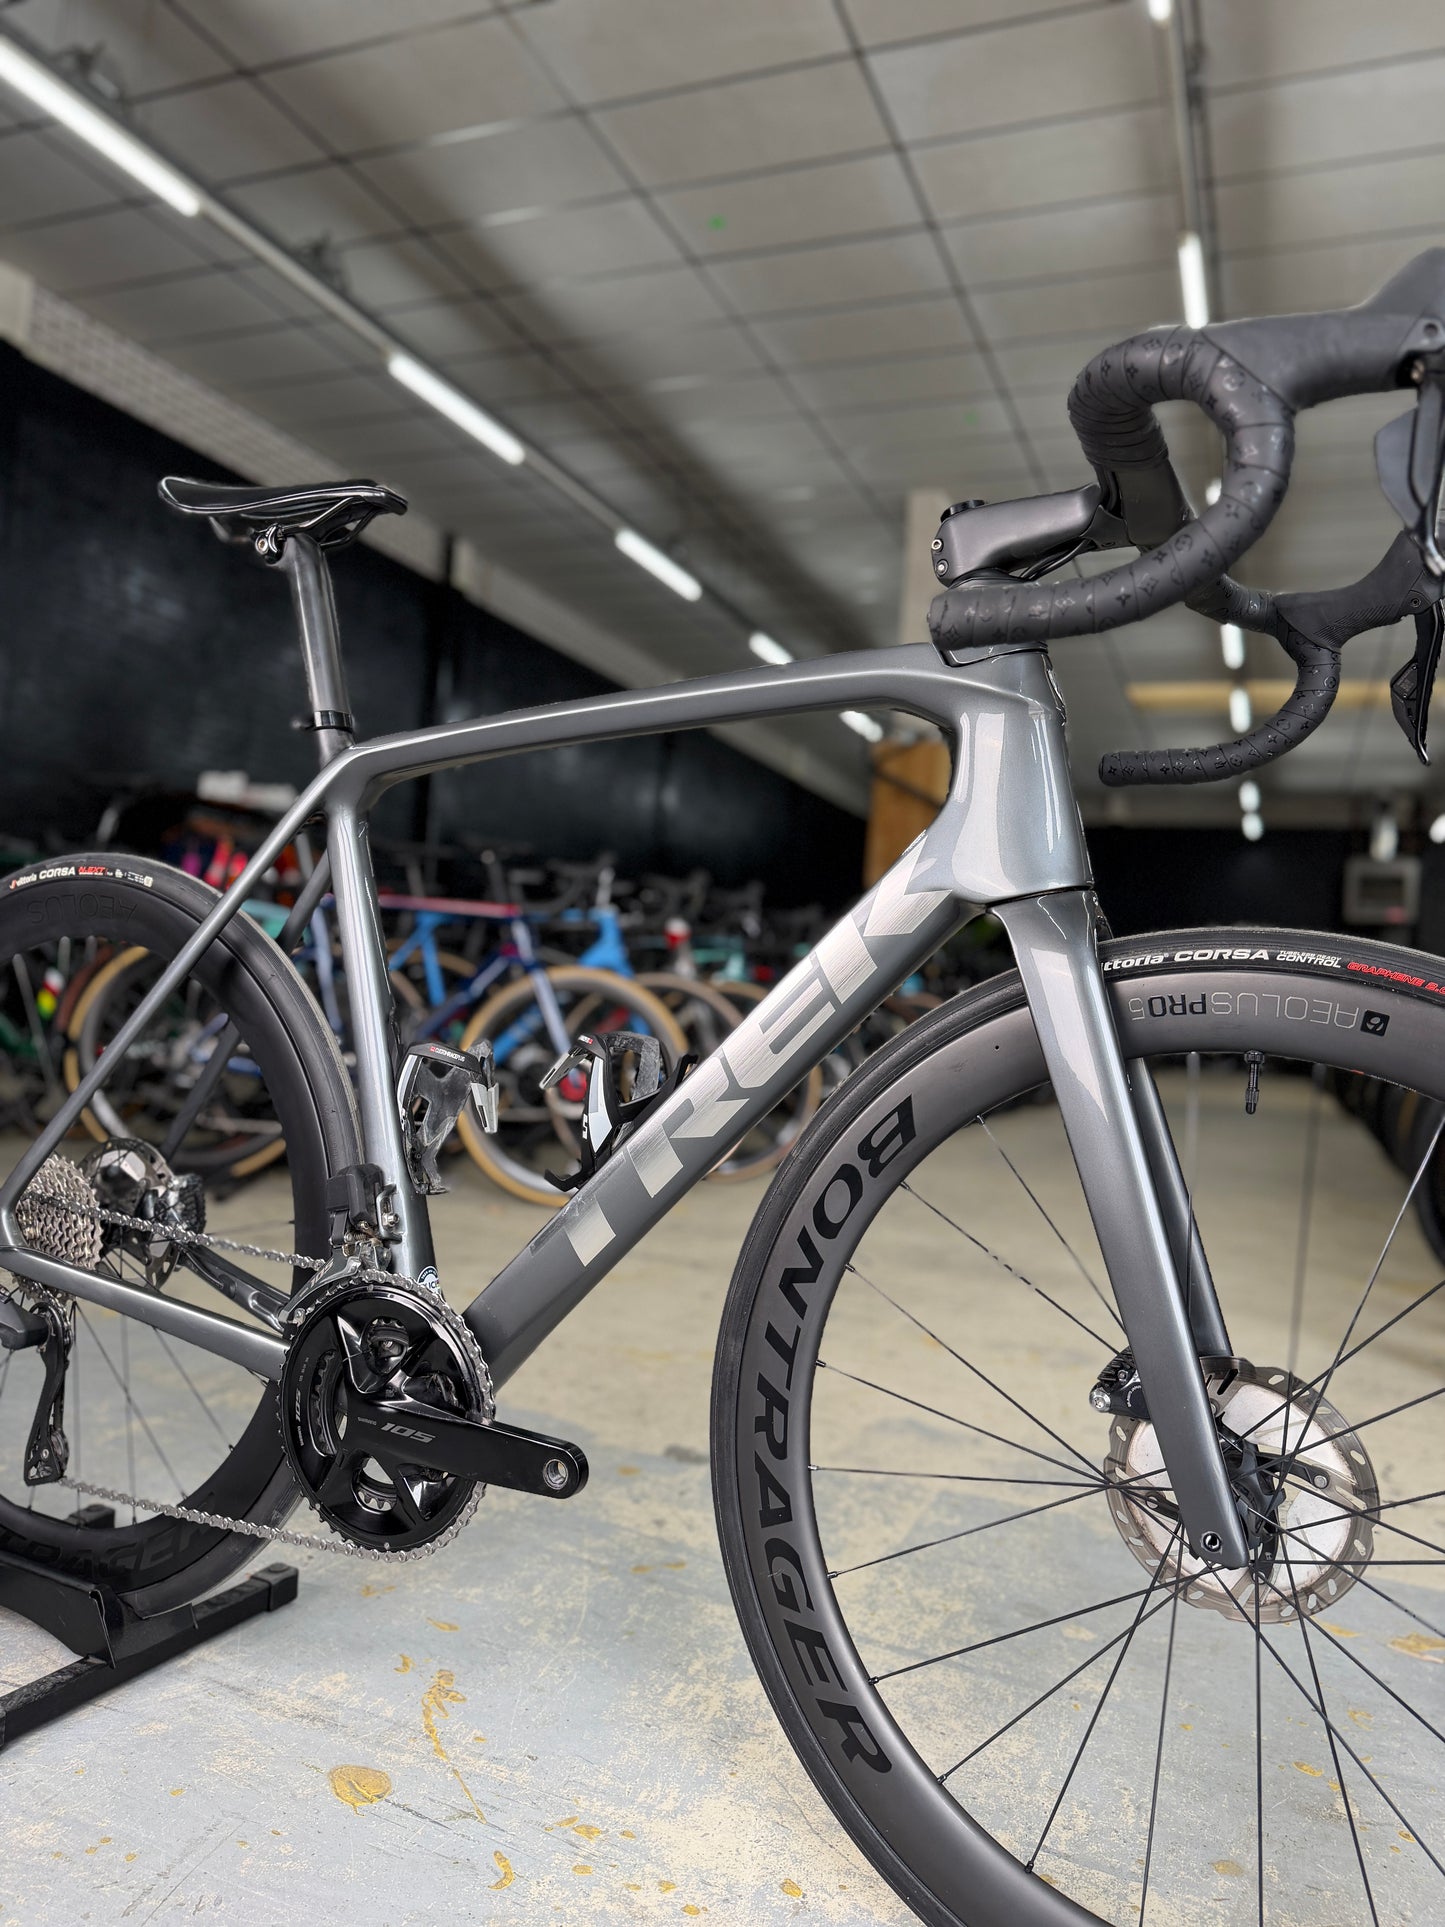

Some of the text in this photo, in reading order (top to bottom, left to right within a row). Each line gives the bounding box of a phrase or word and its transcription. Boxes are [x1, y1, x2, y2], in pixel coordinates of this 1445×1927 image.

[39, 866, 76, 880] CORSA
[27, 892, 138, 924] AEOLUS
[1174, 949, 1270, 962] CORSA
[1276, 954, 1341, 968] CONTROL
[1346, 961, 1426, 987] GRAPHENE
[563, 834, 953, 1267] TREK
[380, 1422, 436, 1443] 105
[754, 1093, 917, 1776] BONTRAGER
